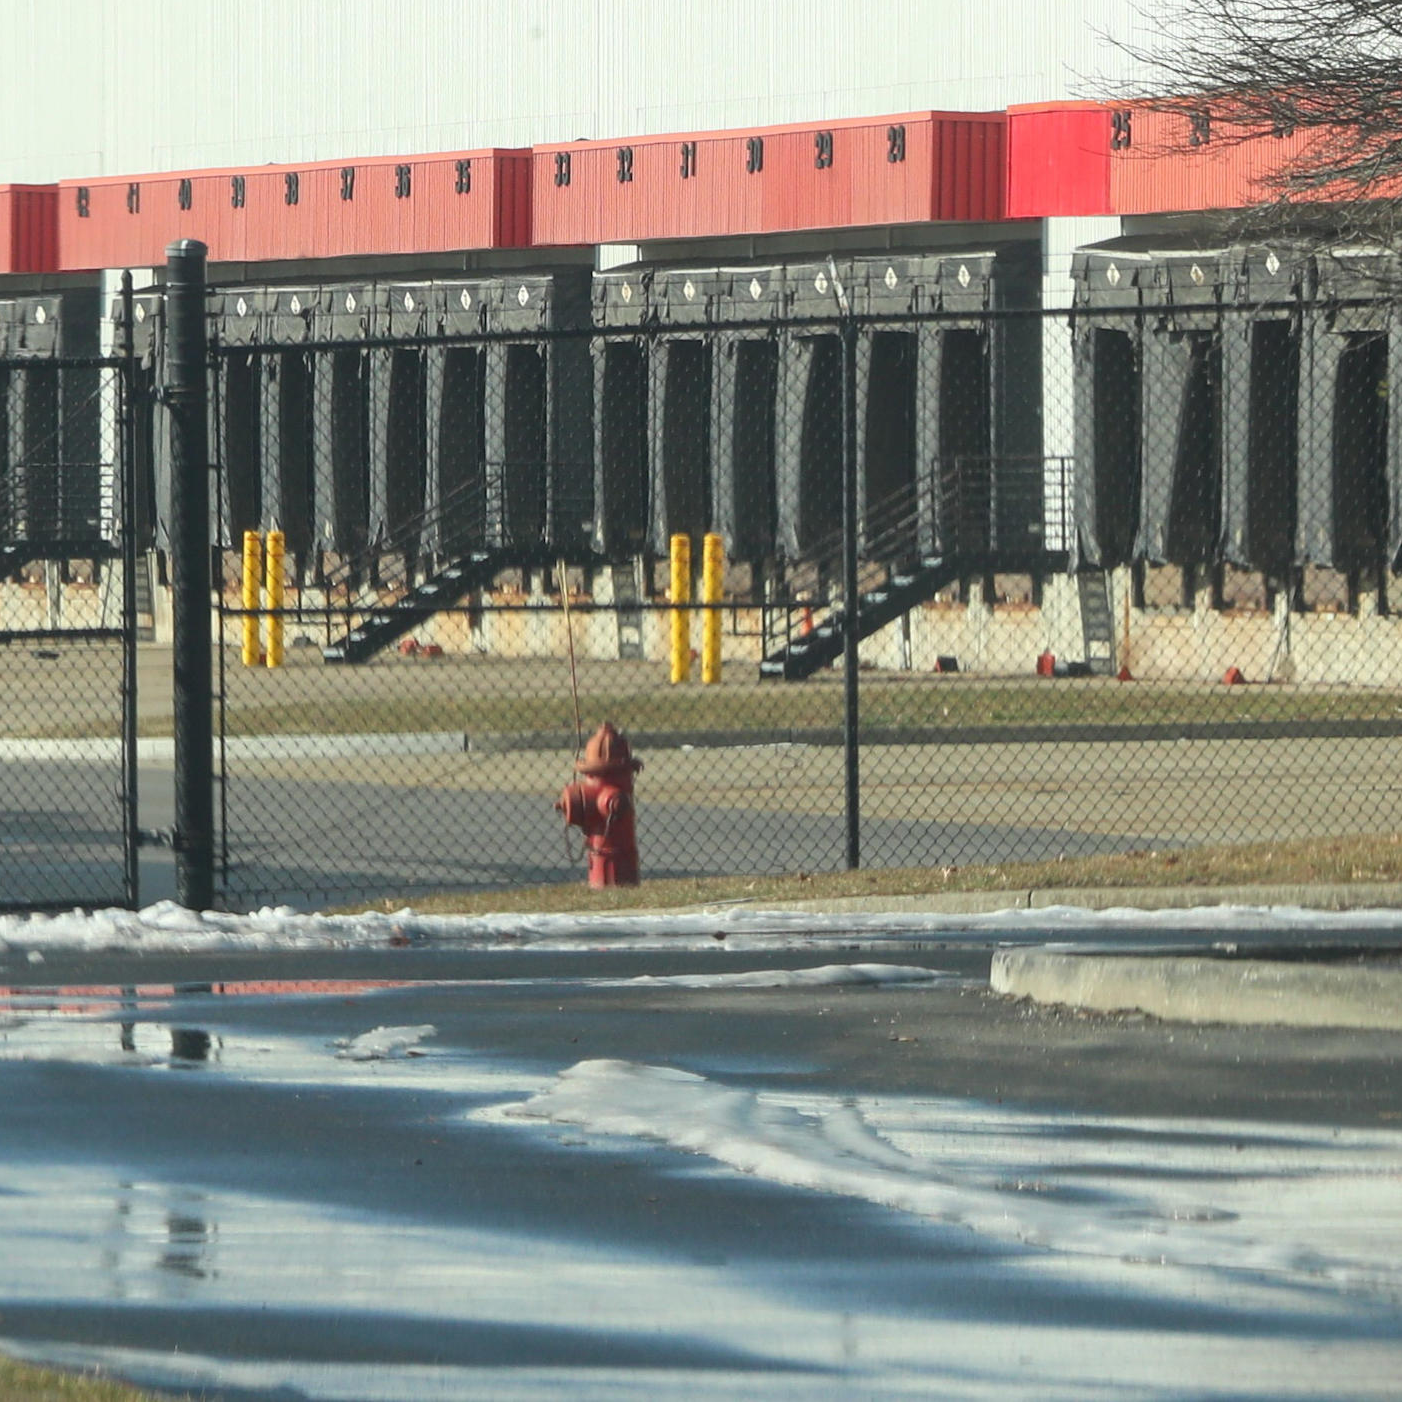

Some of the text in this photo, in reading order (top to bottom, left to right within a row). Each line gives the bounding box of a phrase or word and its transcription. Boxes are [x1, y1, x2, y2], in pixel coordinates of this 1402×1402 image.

[887, 124, 906, 163] 28
[1111, 108, 1131, 150] 25
[617, 146, 633, 183] 32
[680, 141, 696, 179] 31
[747, 136, 763, 174] 30
[815, 131, 833, 169] 29
[340, 166, 354, 200] 37
[394, 163, 410, 198] 36
[454, 159, 470, 194] 35
[554, 151, 571, 187] 33
[231, 174, 245, 208] 39
[285, 171, 298, 205] 38
